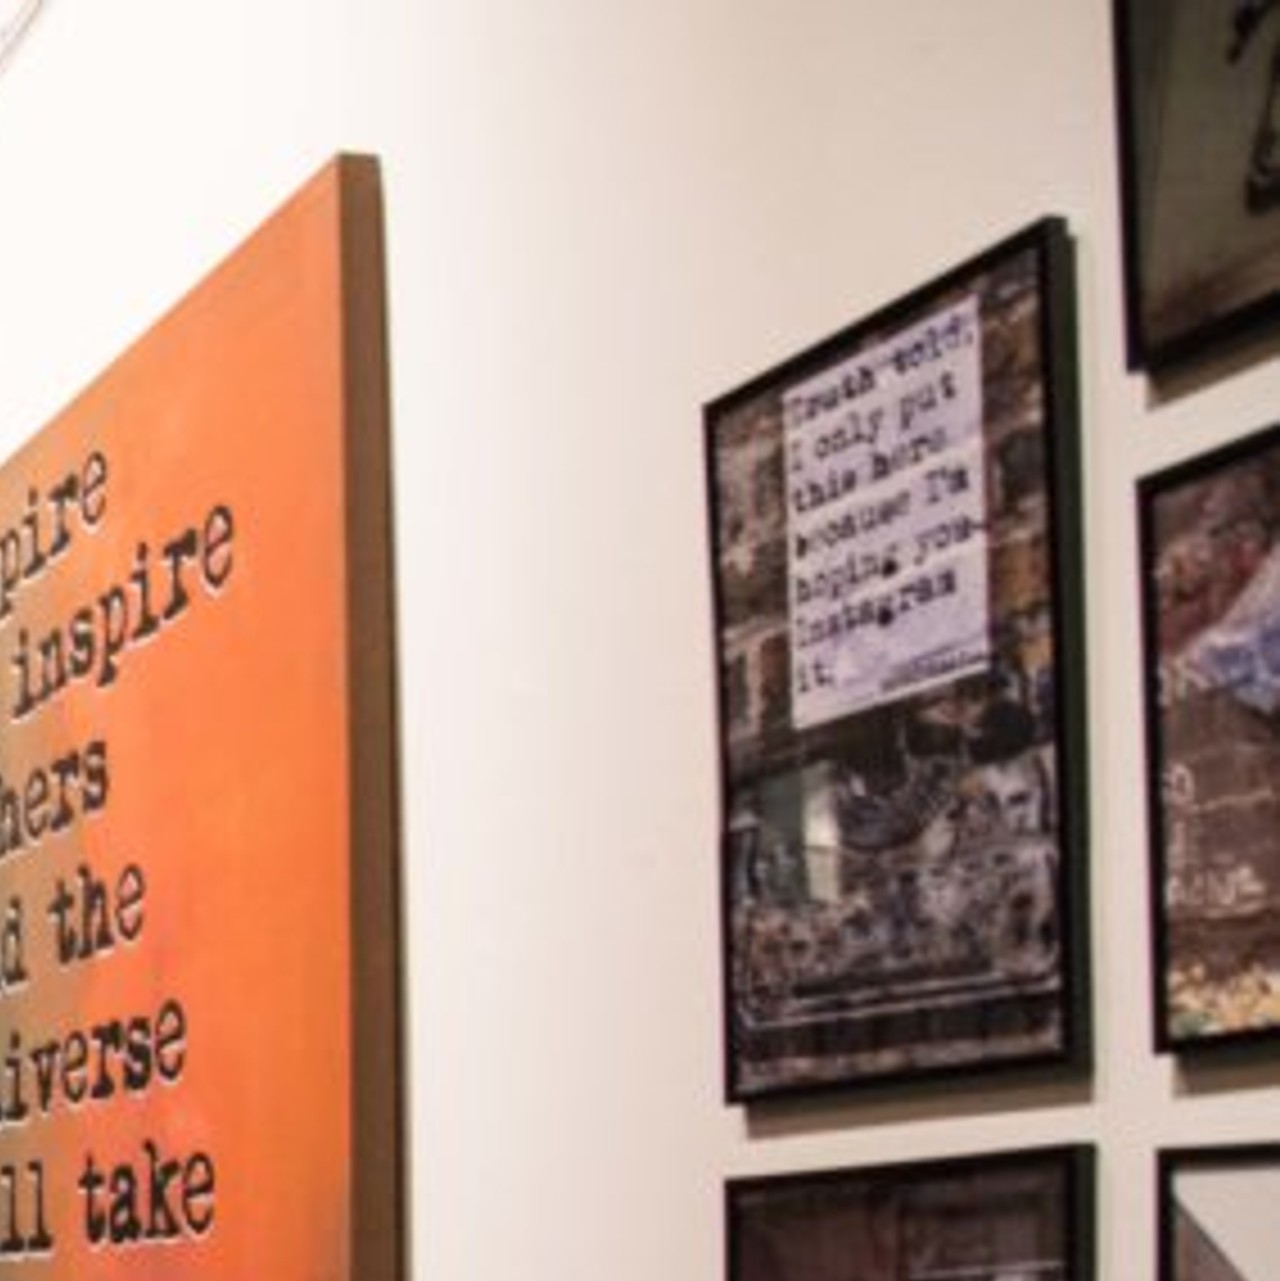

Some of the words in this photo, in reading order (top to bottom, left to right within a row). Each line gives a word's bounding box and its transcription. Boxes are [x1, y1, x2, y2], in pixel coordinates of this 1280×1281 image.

[814, 407, 884, 459] only
[900, 372, 956, 429] put
[793, 470, 856, 512] this
[872, 427, 947, 480] here
[13, 504, 235, 718] inspire
[48, 863, 146, 964] the
[79, 1139, 216, 1244] take
